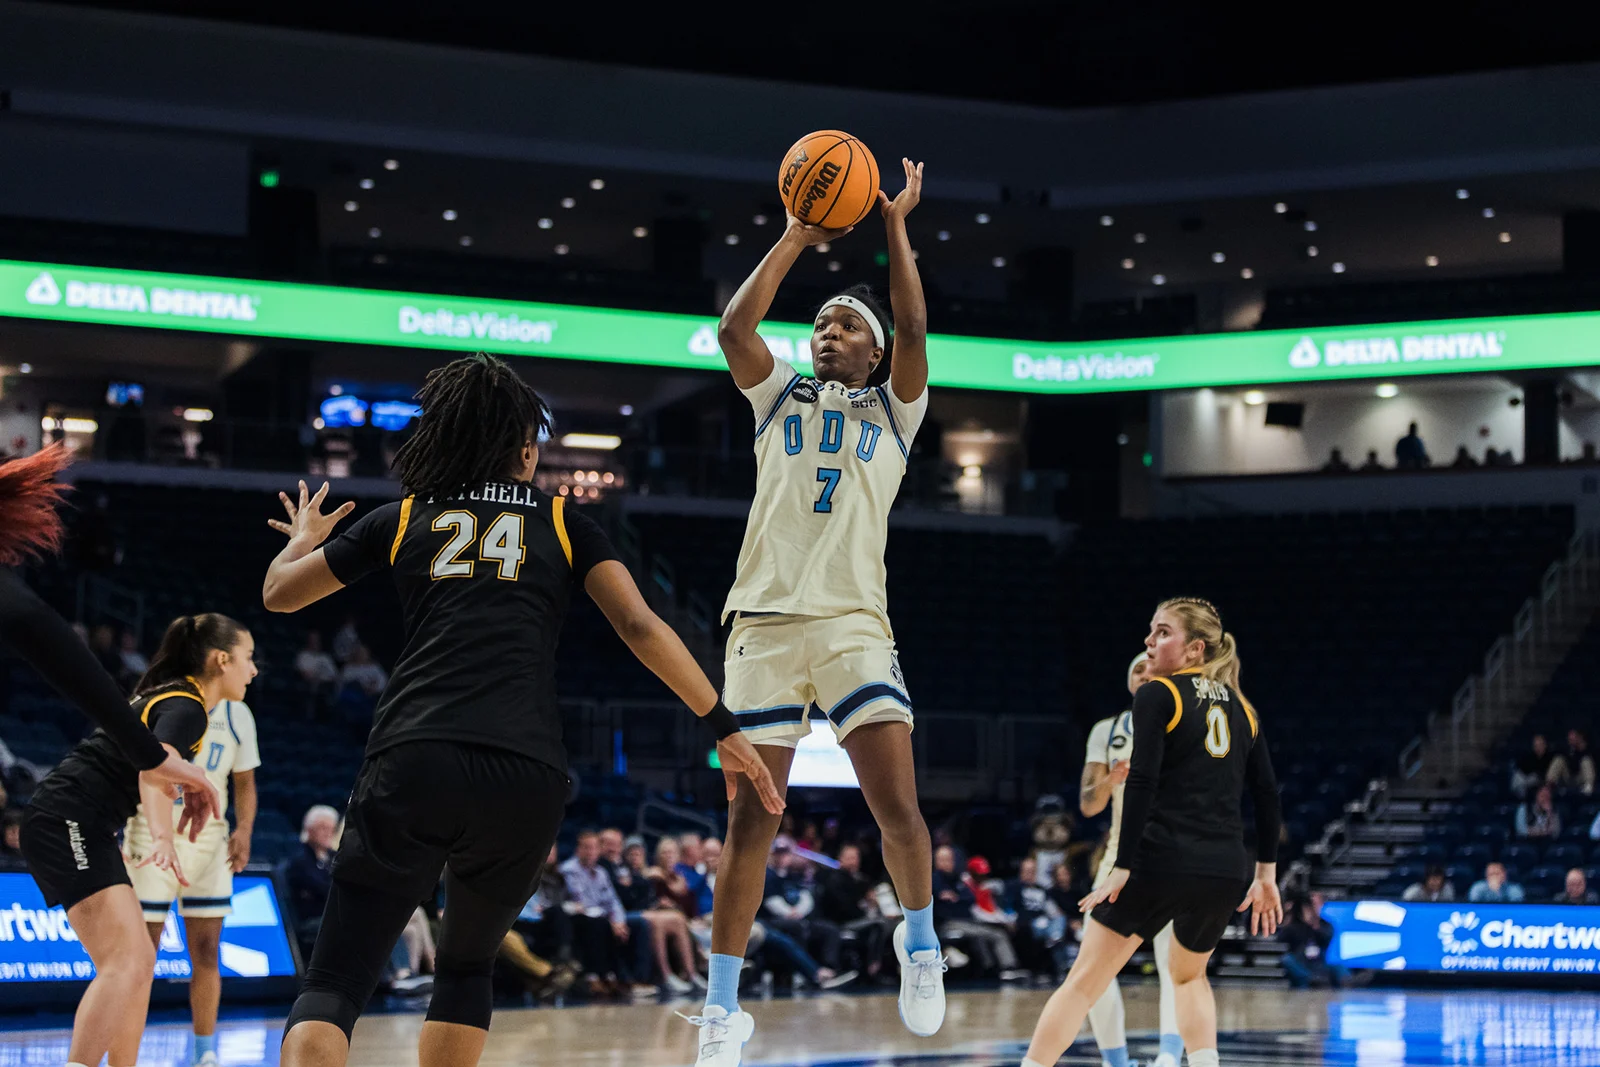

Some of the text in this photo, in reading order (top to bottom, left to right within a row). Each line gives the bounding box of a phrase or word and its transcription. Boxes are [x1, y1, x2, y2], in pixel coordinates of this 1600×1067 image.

[781, 150, 809, 197] NCAA
[798, 161, 842, 218] Wilson
[65, 279, 256, 321] DELTA DENTAL
[398, 305, 551, 344] DeltaVision
[1013, 351, 1155, 382] DeltaVision
[1325, 332, 1504, 366] DELTA DENTAL
[784, 410, 882, 462] ODU
[814, 467, 841, 513] 7
[430, 509, 526, 581] 24
[1204, 705, 1231, 758] 0
[27, 961, 73, 979] UNION
[1502, 956, 1550, 971] CREDIT
[1552, 957, 1596, 972] UNION
